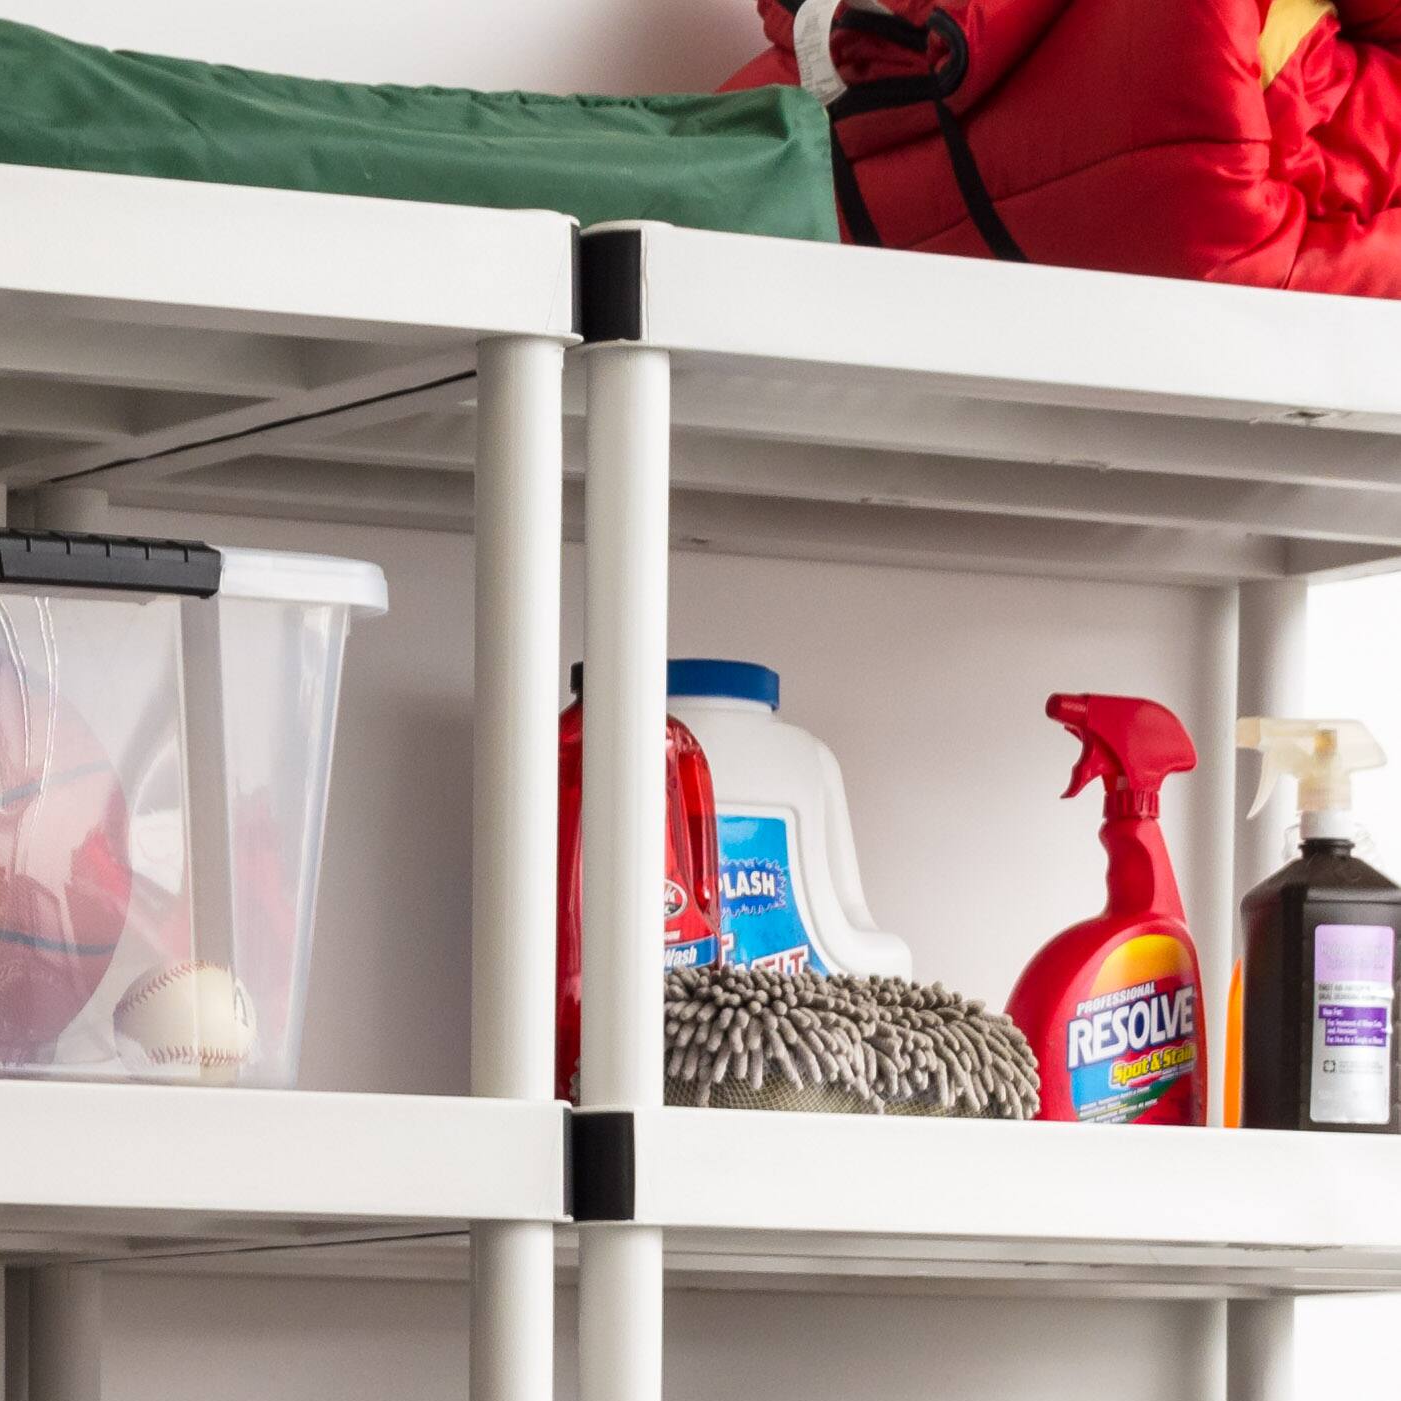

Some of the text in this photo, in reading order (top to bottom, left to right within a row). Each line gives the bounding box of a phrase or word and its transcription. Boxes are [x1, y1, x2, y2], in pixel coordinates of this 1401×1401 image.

[1076, 981, 1156, 1017] PROFESSIONAL
[1068, 986, 1194, 1069] RESOLVE
[1112, 1057, 1149, 1086] Spot
[1149, 1051, 1161, 1071] &
